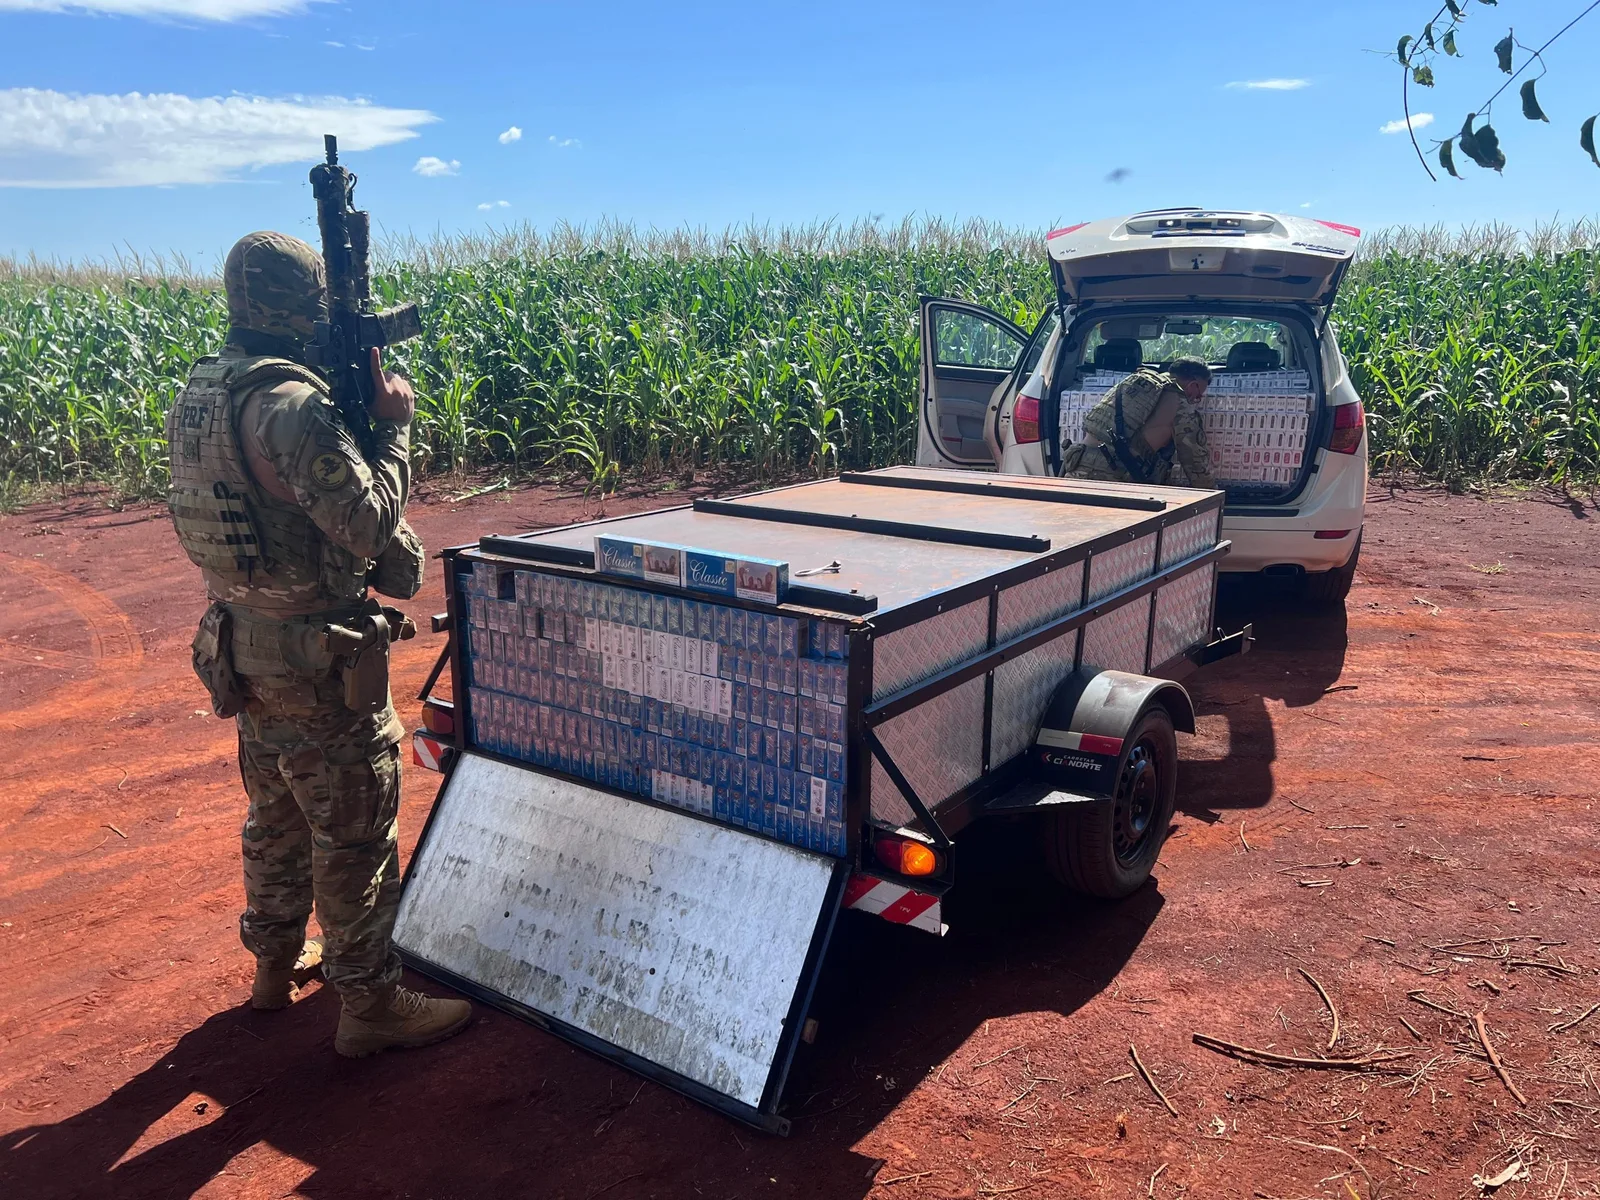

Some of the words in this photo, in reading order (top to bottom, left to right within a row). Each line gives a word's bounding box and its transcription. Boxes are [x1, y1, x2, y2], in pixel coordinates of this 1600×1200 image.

[603, 544, 637, 569] Classic
[690, 559, 728, 586] Classic
[1063, 755, 1095, 763] CARRETAS
